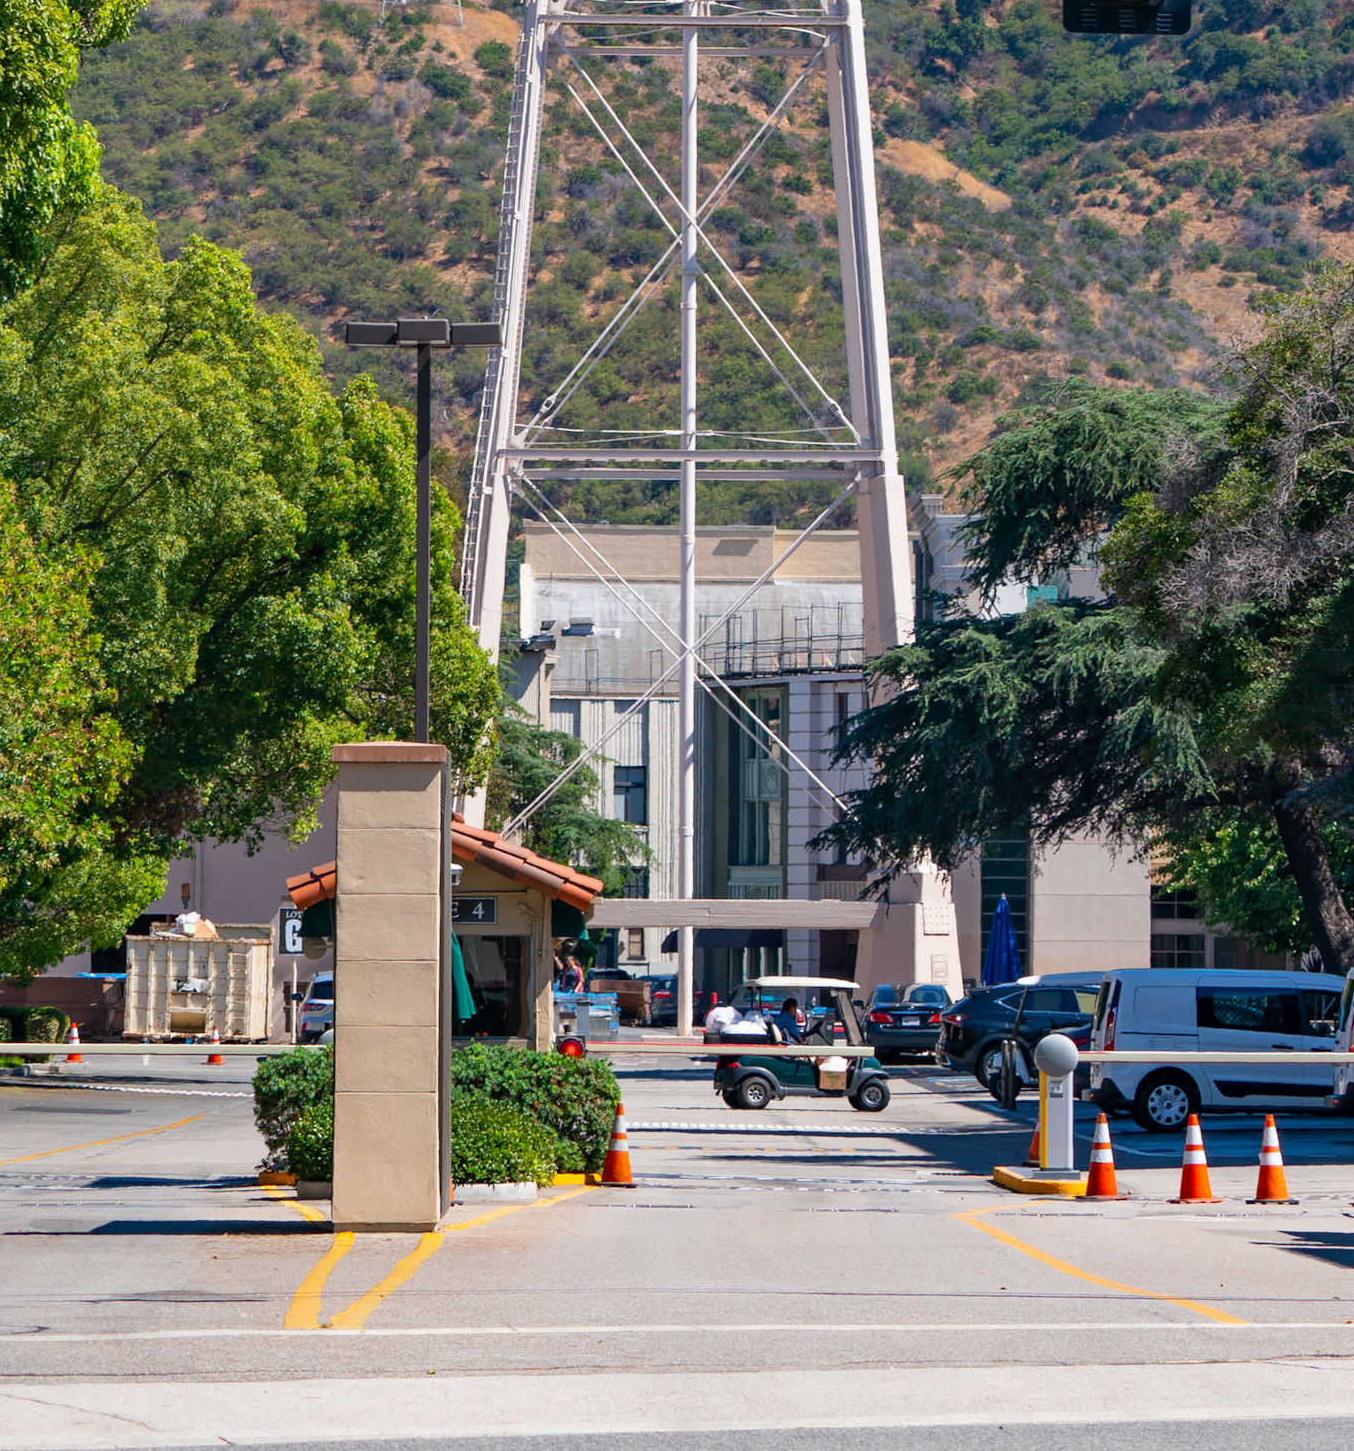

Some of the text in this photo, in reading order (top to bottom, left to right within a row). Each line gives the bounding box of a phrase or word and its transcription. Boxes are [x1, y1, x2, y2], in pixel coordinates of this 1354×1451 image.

[285, 911, 303, 919] LOT
[472, 901, 484, 920] 4
[285, 919, 303, 953] G
